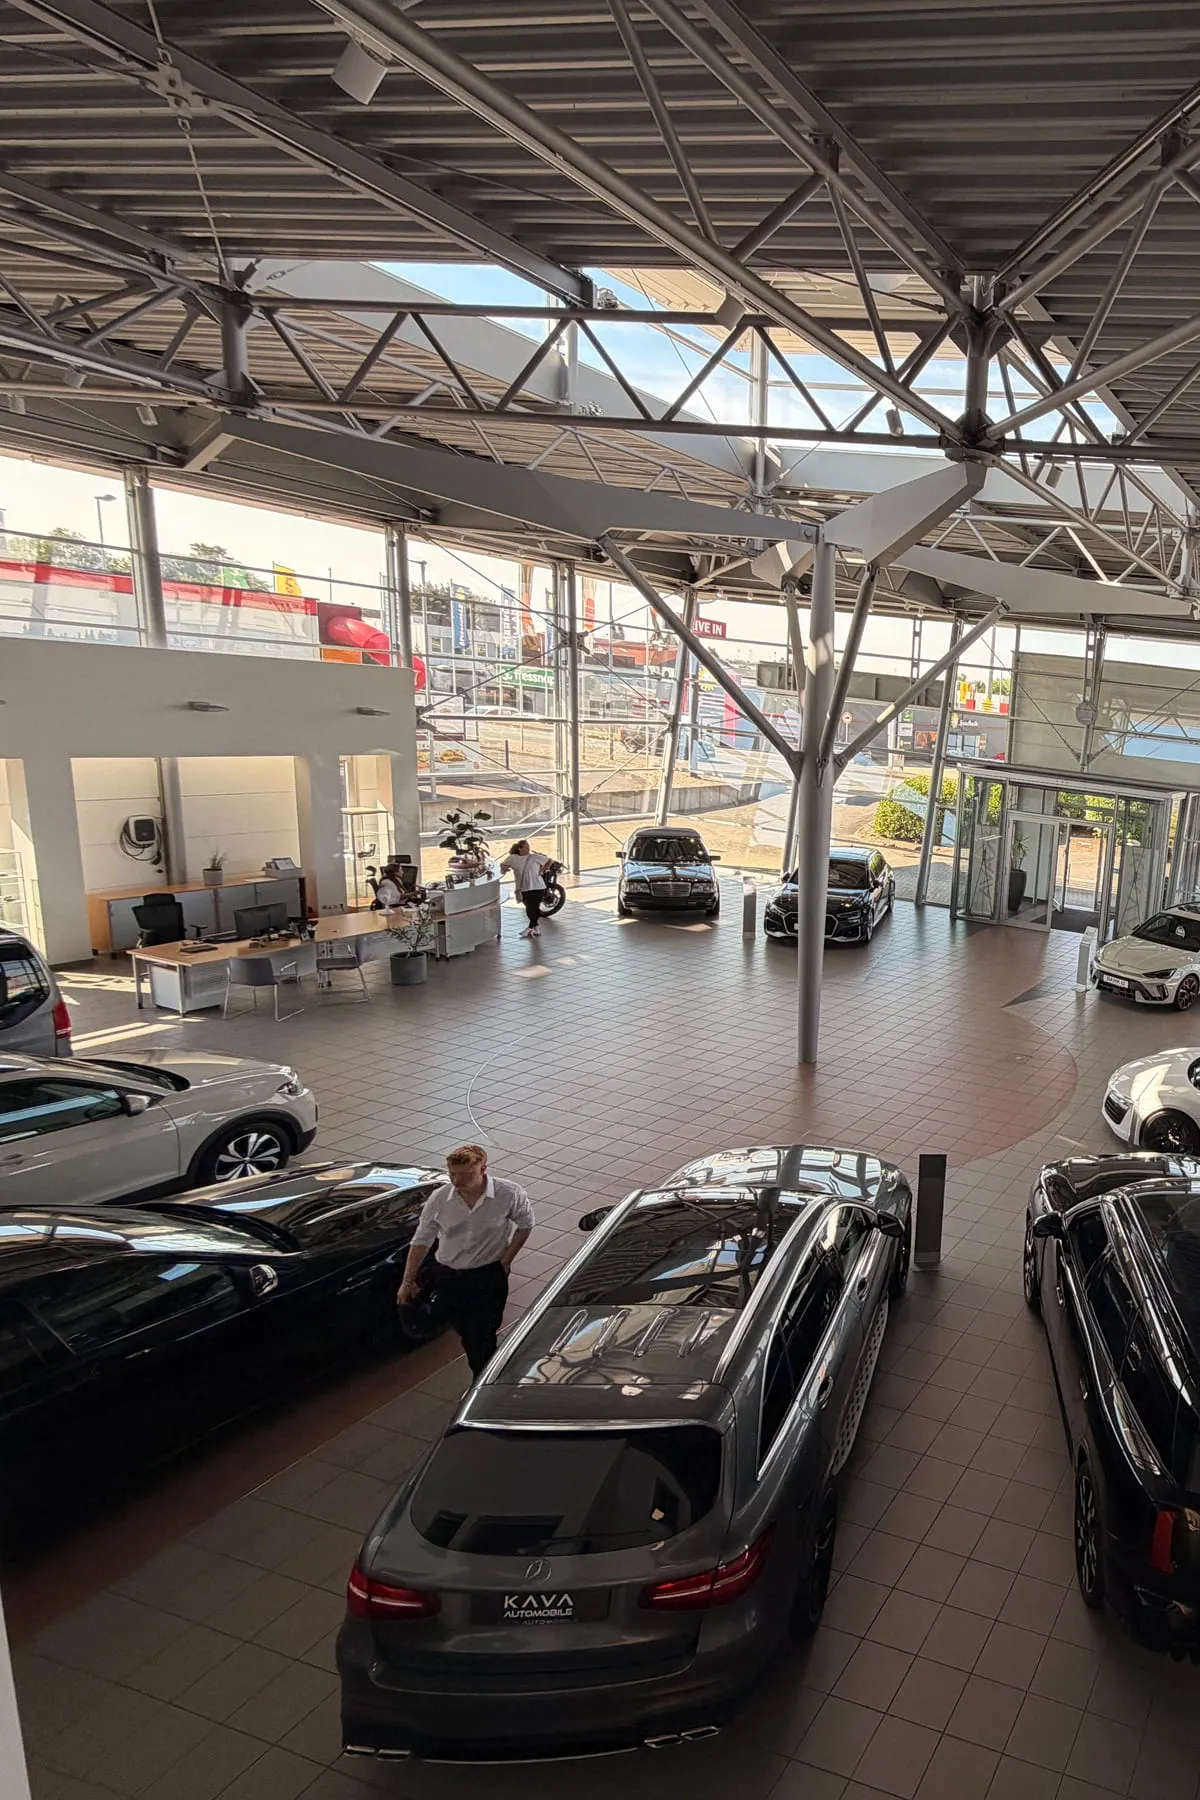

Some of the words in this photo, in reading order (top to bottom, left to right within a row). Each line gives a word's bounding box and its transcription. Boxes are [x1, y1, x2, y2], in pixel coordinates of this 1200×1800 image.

[712, 623, 723, 636] IN
[503, 1592, 574, 1609] KAVA
[503, 1607, 573, 1618] AUTOMOBILE
